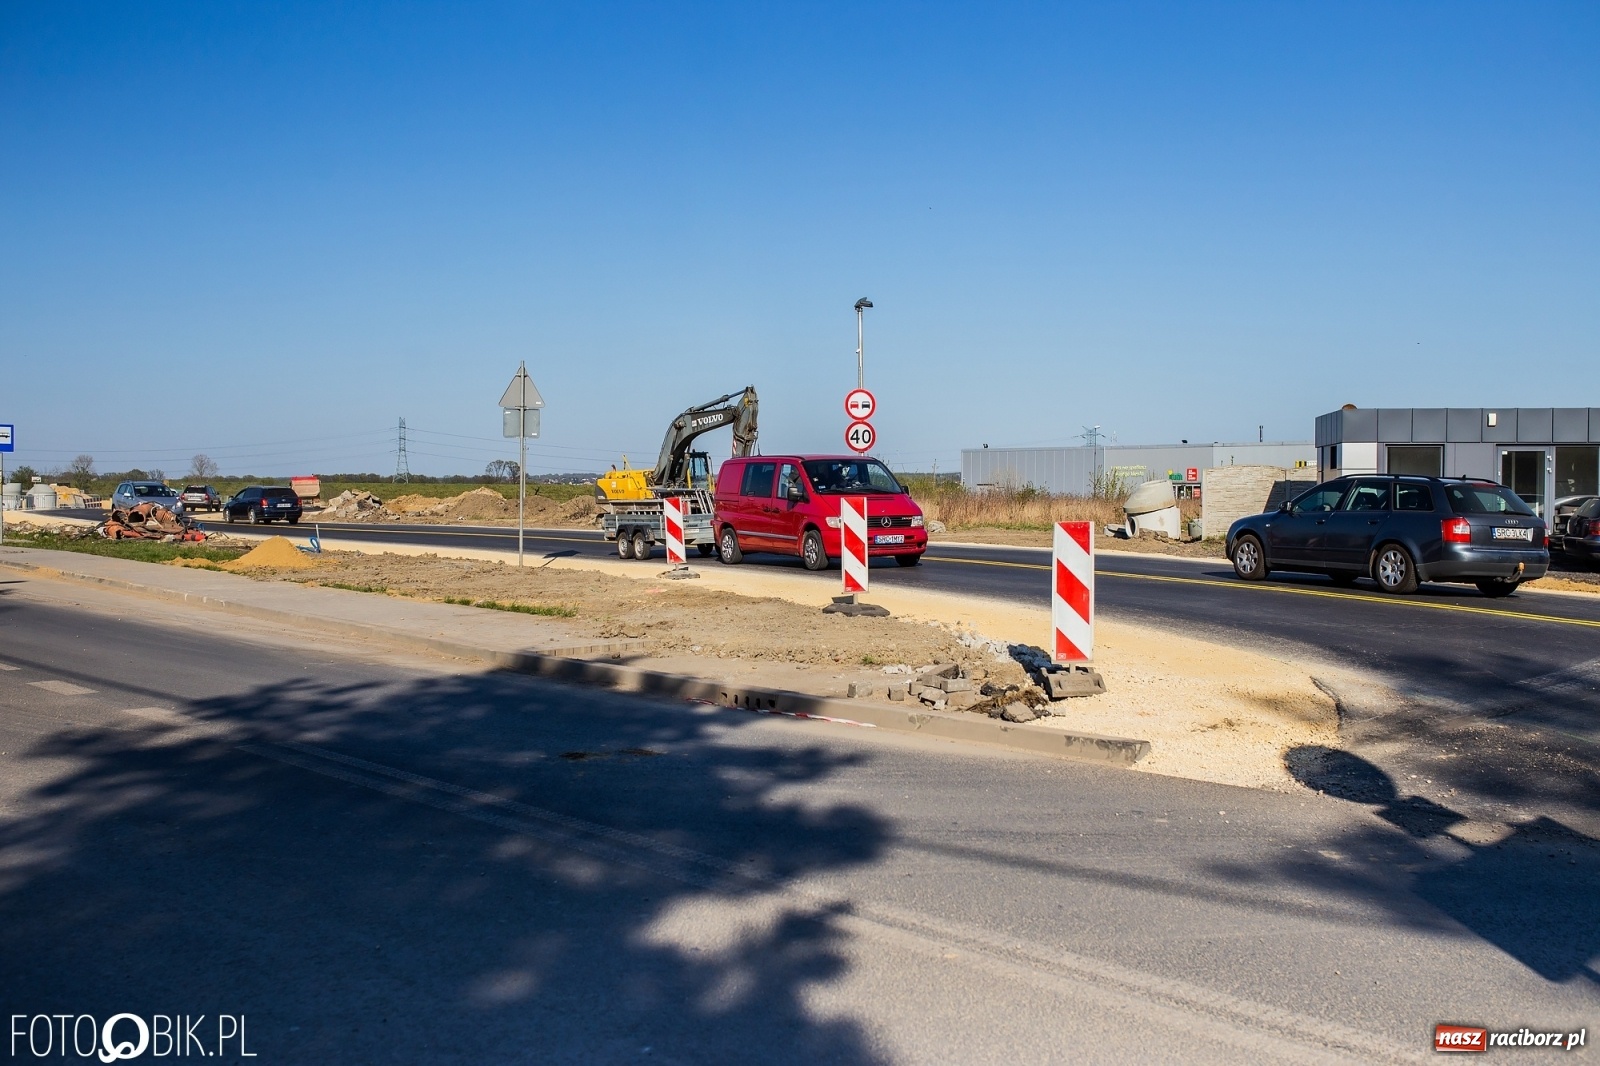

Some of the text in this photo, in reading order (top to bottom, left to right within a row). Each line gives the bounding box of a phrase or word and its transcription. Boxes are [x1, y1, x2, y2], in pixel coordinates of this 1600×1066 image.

[698, 413, 723, 426] VOLVO
[850, 429, 871, 444] 40
[1496, 528, 1511, 537] SRC
